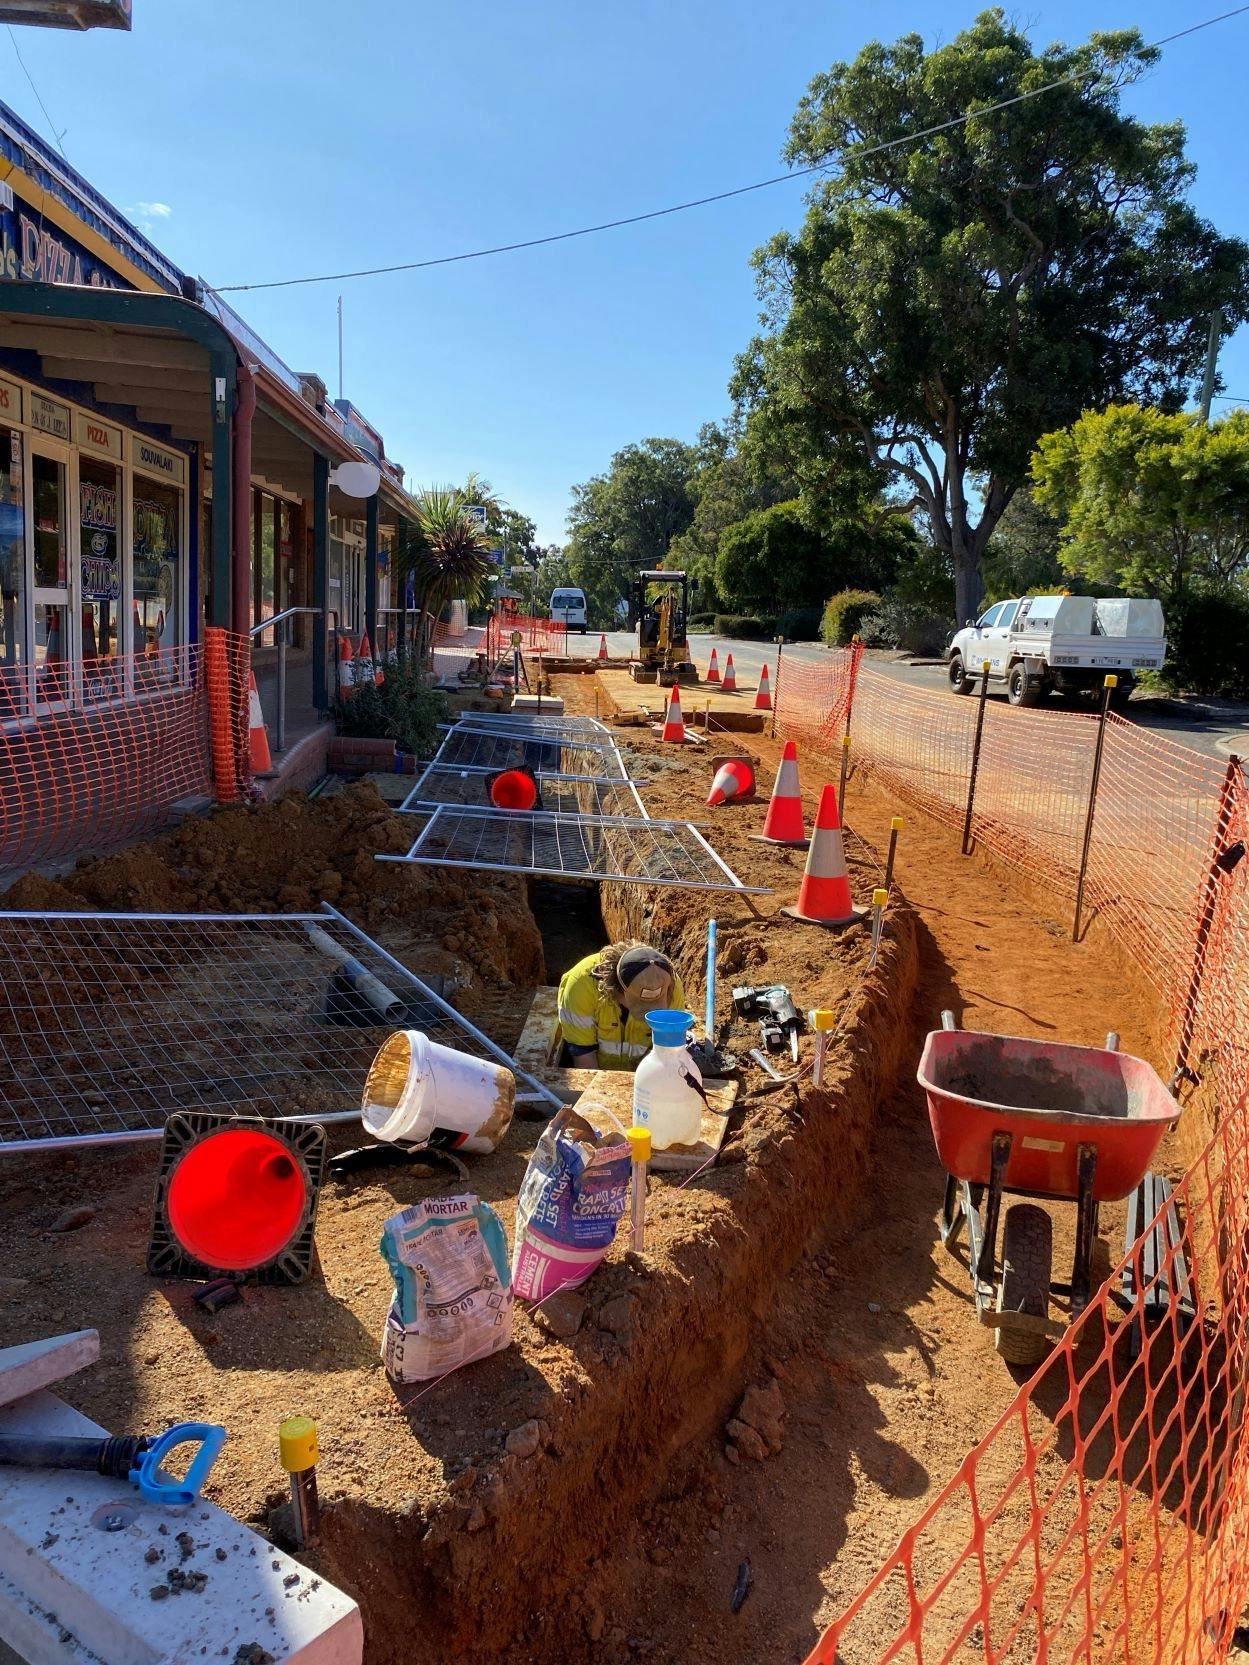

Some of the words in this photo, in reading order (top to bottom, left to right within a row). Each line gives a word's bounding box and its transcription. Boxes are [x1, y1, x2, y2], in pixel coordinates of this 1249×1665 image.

[20, 213, 83, 284] PIZZA
[87, 425, 109, 448] PIZZA
[140, 446, 173, 473] SOUVALAKI
[424, 1202, 469, 1215] MORTAR
[545, 1202, 560, 1229] SET
[525, 1252, 539, 1297] CEMENT
